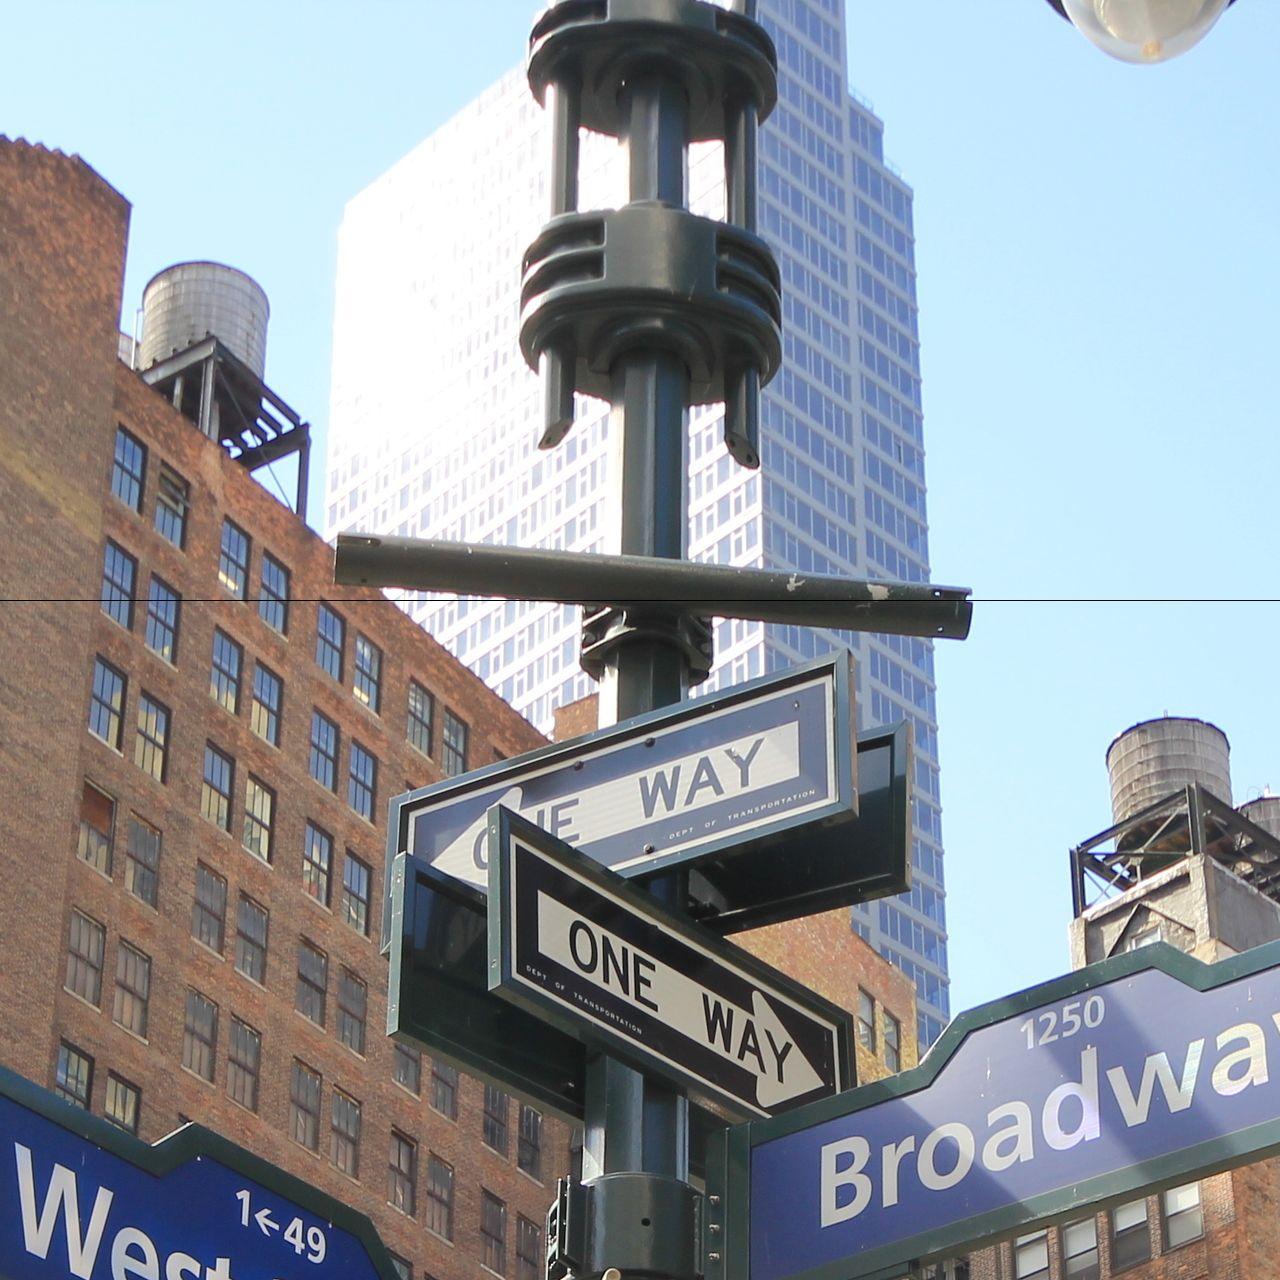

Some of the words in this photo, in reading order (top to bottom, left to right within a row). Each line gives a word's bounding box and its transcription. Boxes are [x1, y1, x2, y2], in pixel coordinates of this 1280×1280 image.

[639, 737, 765, 819] WAY
[669, 827, 694, 840] DEPT
[705, 820, 716, 829] OF
[728, 789, 816, 821] TRANSPORTATION
[526, 965, 547, 980] DEPT
[555, 982, 565, 991] OF
[574, 992, 642, 1035] TRANSPORTATION
[569, 919, 659, 1013] ONE
[702, 994, 794, 1084] WAY
[1020, 995, 1106, 1050] 1250
